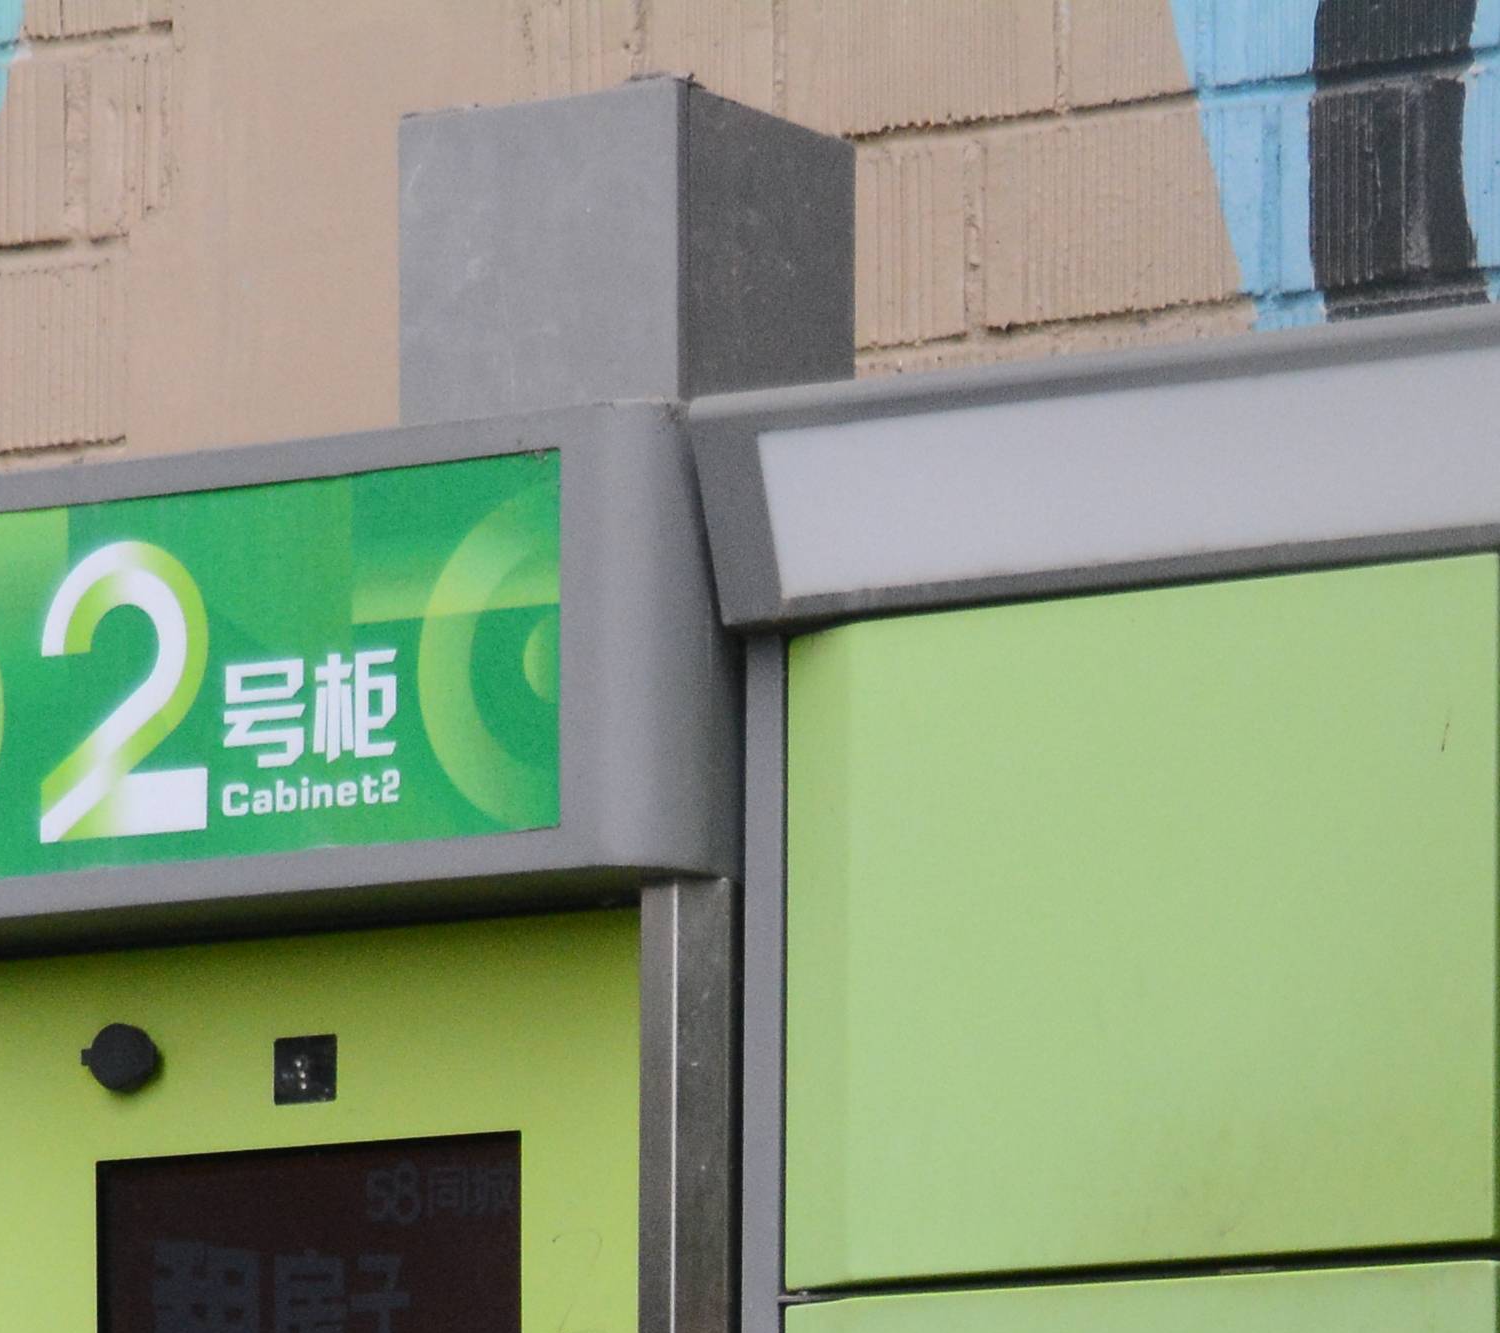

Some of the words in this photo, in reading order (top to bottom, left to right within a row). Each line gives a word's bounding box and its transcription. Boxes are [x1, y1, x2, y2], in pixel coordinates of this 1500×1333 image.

[41, 541, 208, 843] 2
[222, 649, 397, 768] 号柜
[222, 770, 401, 818] Cabinet2
